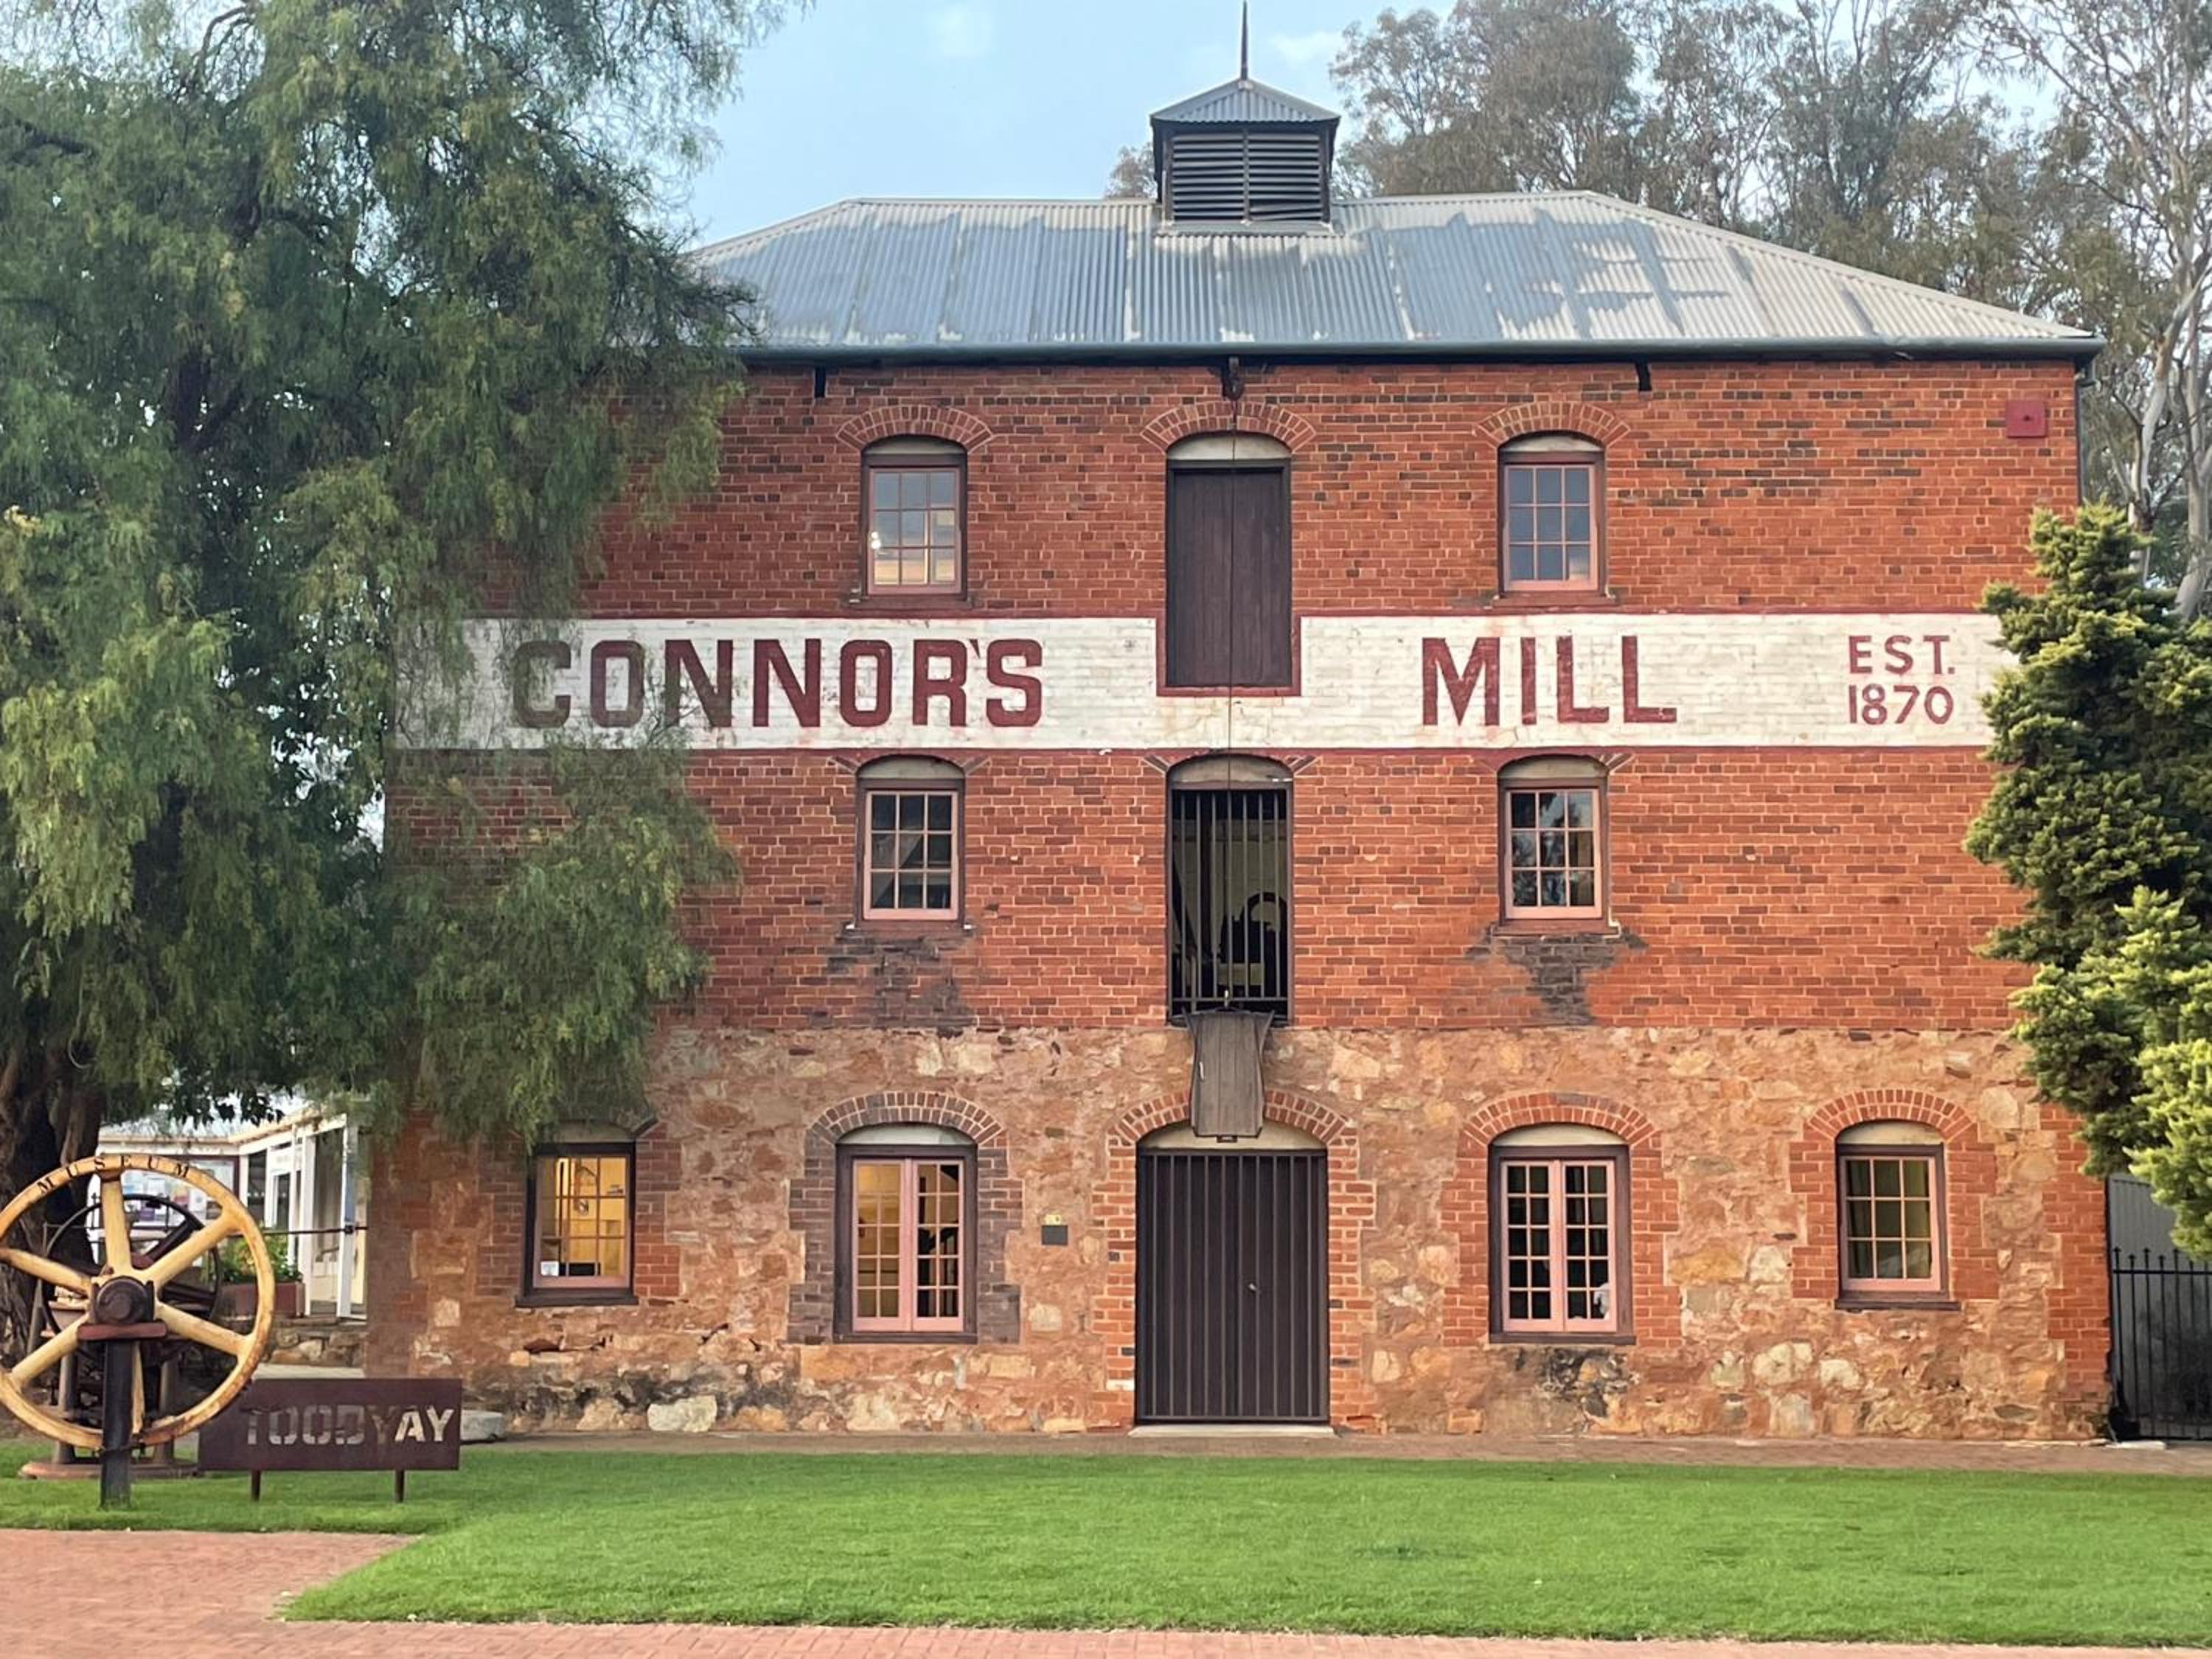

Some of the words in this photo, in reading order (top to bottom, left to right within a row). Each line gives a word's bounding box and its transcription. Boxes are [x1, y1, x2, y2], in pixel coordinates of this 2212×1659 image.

[1848, 635, 1955, 674] EST.
[512, 639, 1042, 728] CONNOR'S
[1422, 636, 1677, 726] MILL
[1848, 684, 1954, 725] 1870
[37, 1155, 189, 1194] MUSEUM
[242, 1405, 455, 1445] TOODYAY
